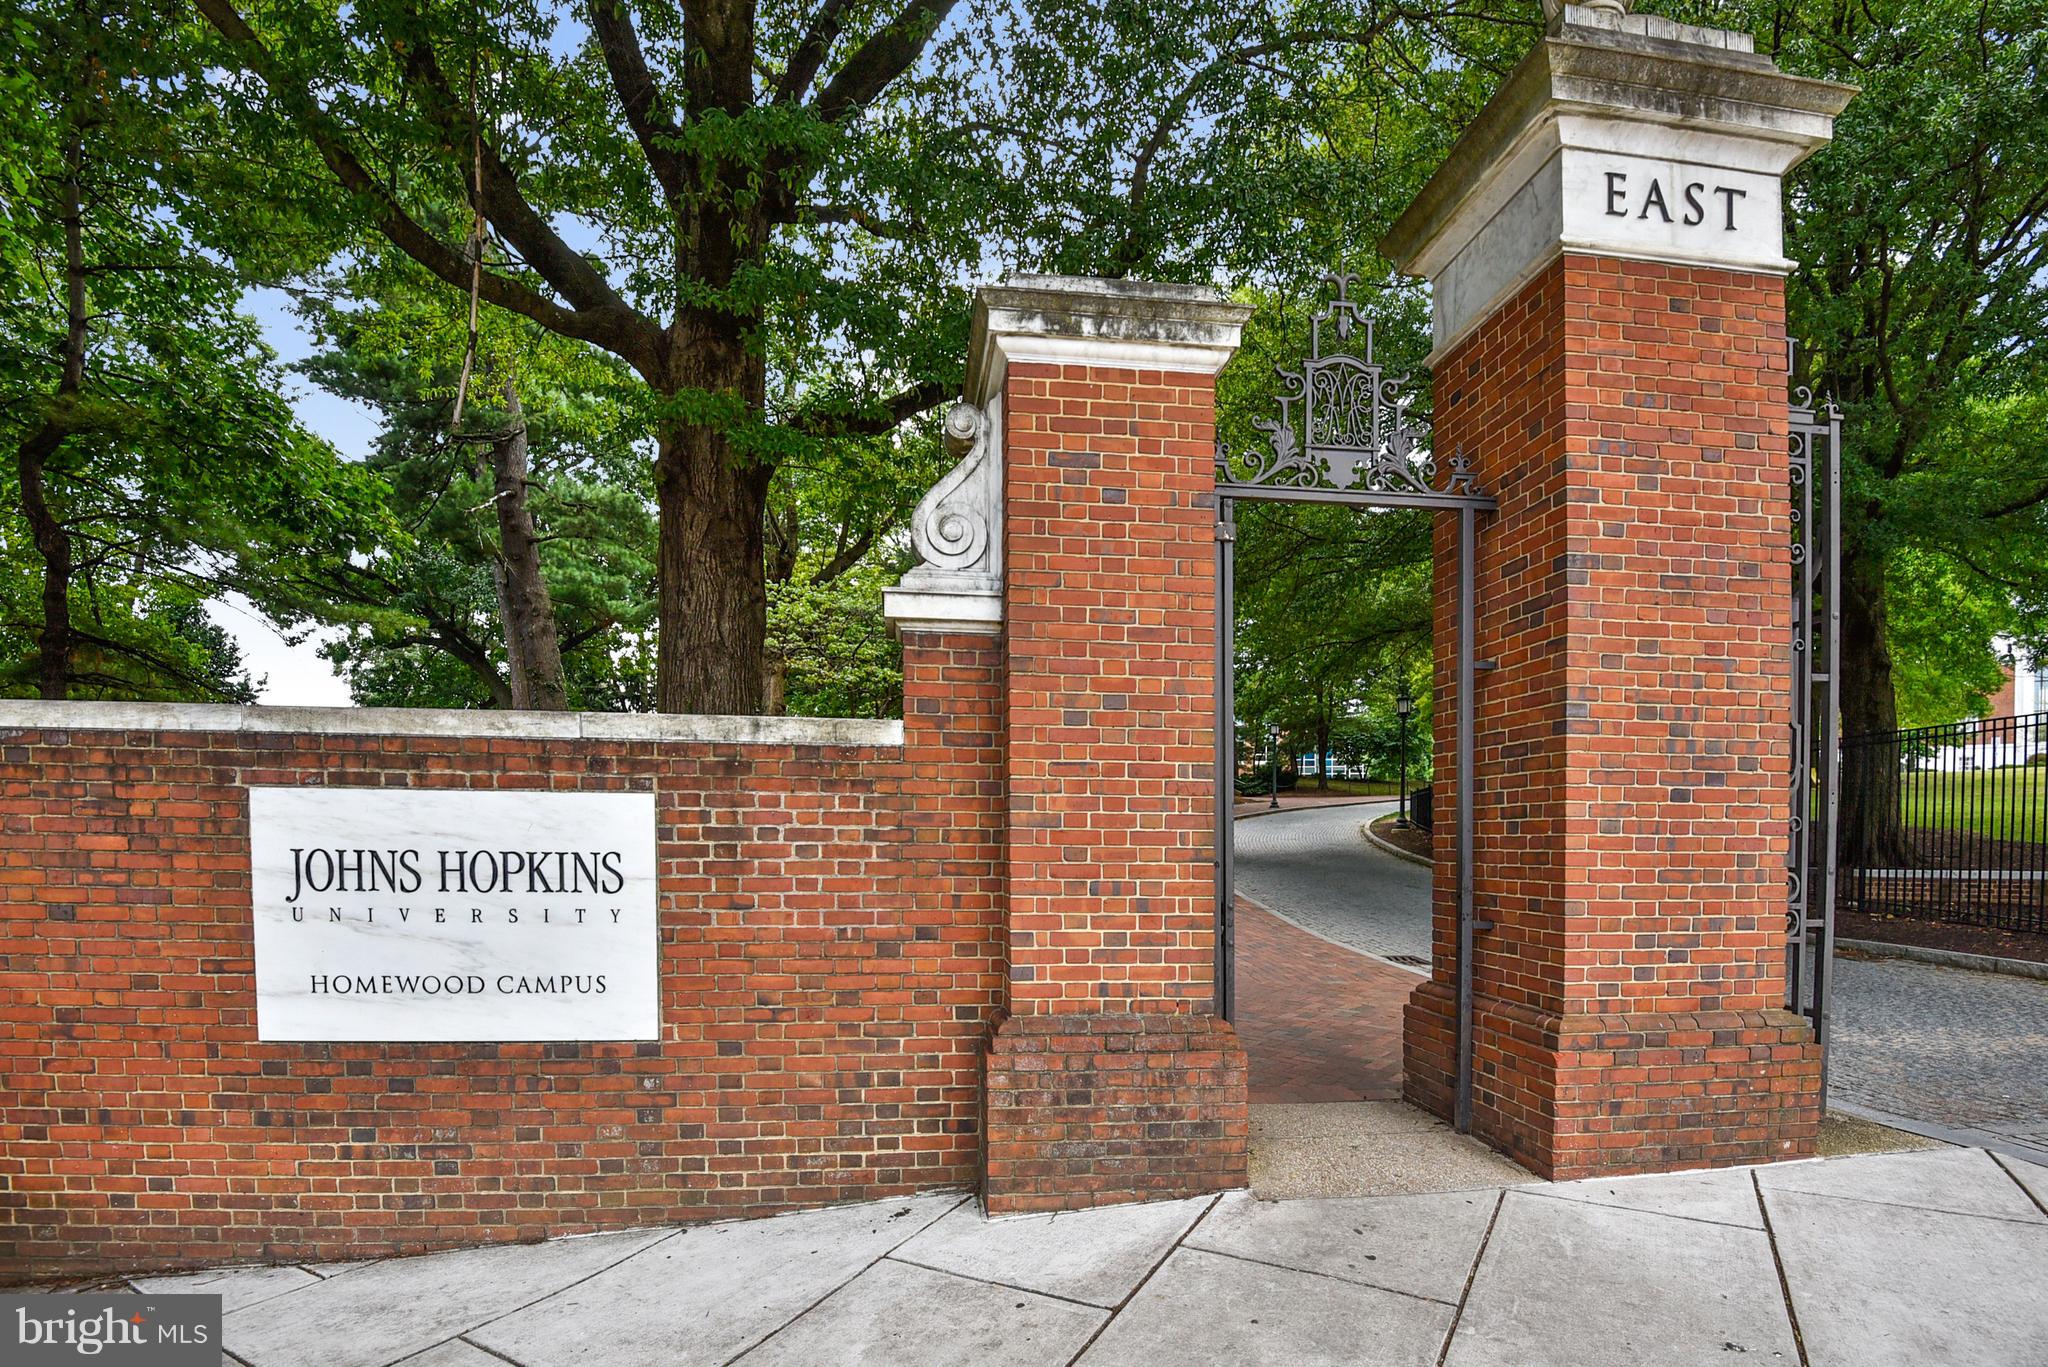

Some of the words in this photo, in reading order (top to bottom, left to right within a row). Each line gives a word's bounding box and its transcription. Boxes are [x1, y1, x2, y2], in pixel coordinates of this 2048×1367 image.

[1604, 172, 1747, 231] EAST
[285, 848, 423, 903] JOHNS
[437, 849, 624, 893] HOPKINS
[292, 907, 622, 924] UNIVERSITY
[310, 974, 485, 995] HOMEWOOD
[496, 974, 607, 995] CAMPUS
